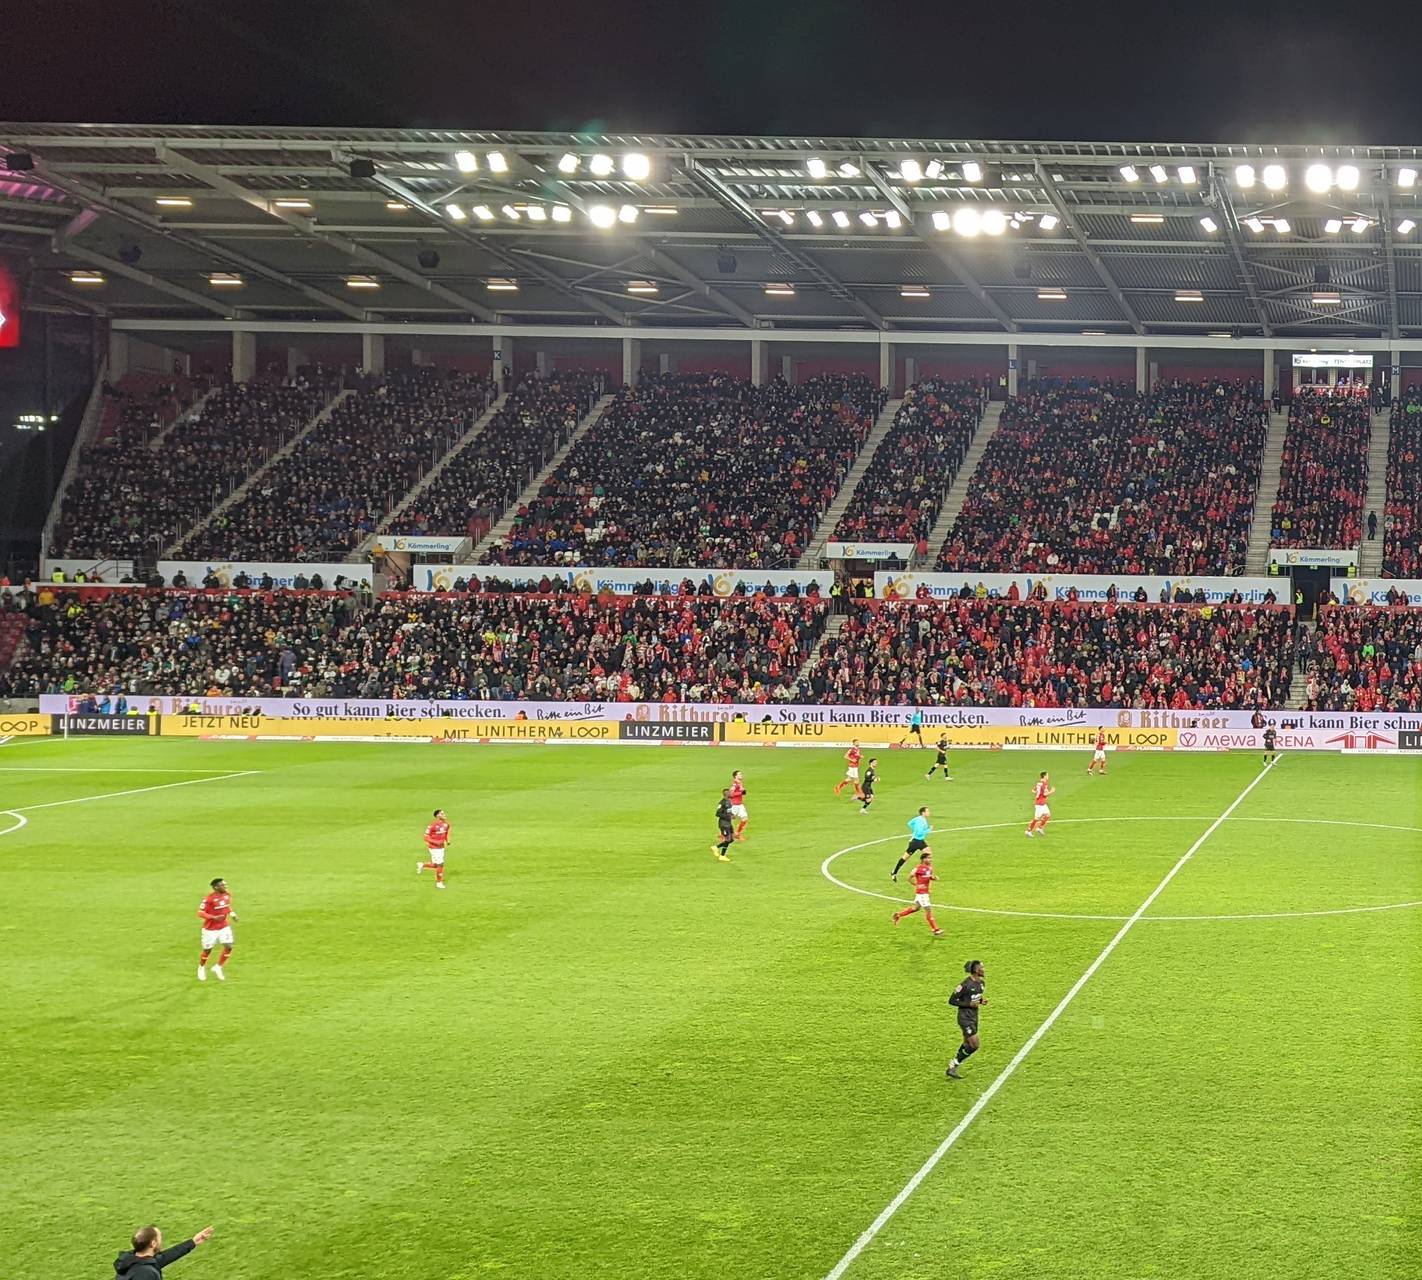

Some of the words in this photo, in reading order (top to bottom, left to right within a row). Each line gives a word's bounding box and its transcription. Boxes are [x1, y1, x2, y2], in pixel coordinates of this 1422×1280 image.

[408, 542, 450, 552] Kömmerling
[856, 549, 897, 557] Kömmerlin
[1300, 555, 1341, 564] Kömmerling
[1055, 586, 1139, 601] Kömmeing
[293, 702, 310, 716] So
[316, 704, 338, 717] gut
[344, 703, 379, 716] kann
[421, 705, 506, 719] schmecken.
[183, 717, 224, 728] JETZT
[230, 717, 260, 728] NEU
[779, 709, 797, 721] So
[802, 710, 824, 723] gut
[830, 710, 865, 723] kann
[871, 710, 900, 724] Bier
[905, 710, 989, 725] shmecken.
[1310, 716, 1344, 729] kann
[1350, 716, 1379, 729] Bier
[59, 719, 144, 730] LINZMEIER
[747, 724, 790, 735] JETZT
[794, 724, 824, 735] NEU
[444, 730, 469, 739] MIT
[476, 726, 561, 737] LINITHERM
[626, 726, 709, 737] LINZMEIER
[1036, 733, 1120, 744] LINITHEM
[1274, 736, 1314, 747] RENA
